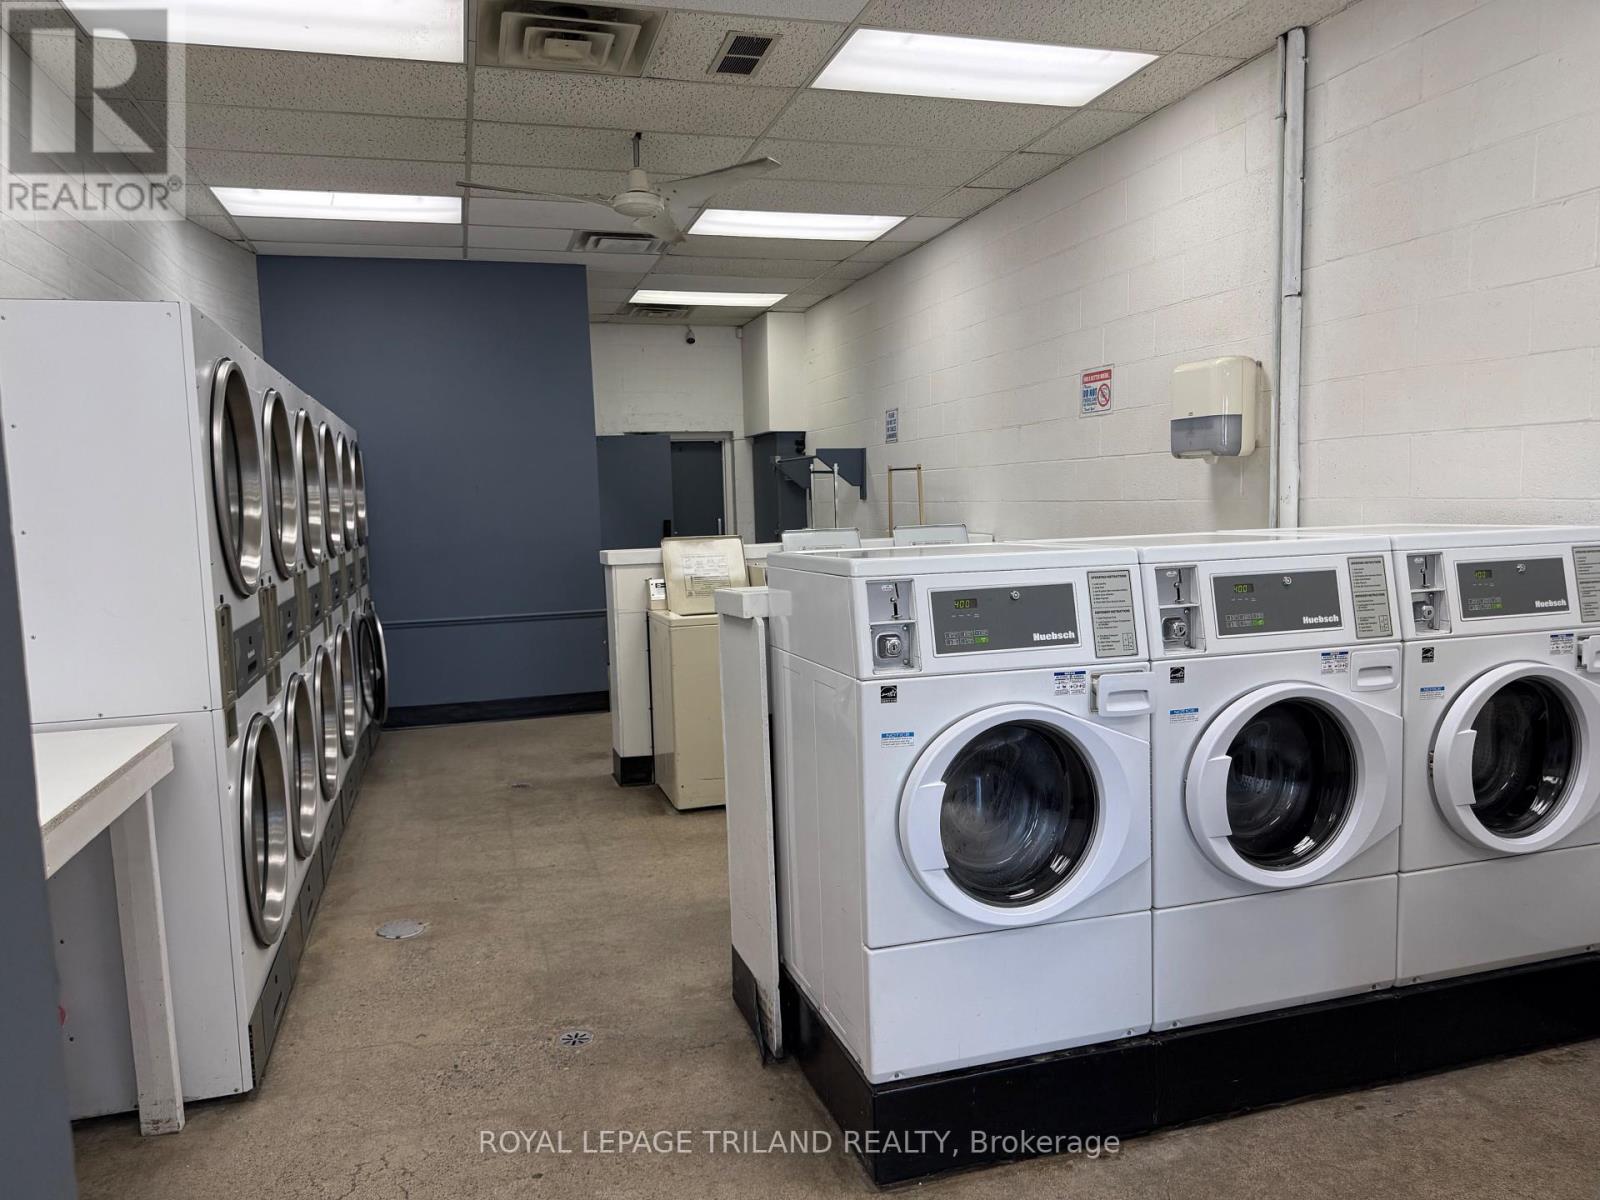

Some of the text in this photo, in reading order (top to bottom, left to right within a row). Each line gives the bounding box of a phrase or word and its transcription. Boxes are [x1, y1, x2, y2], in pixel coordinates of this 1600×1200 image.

[953, 600, 970, 609] 400
[1303, 614, 1340, 625] Huebsch
[1032, 630, 1076, 641] Huebsch
